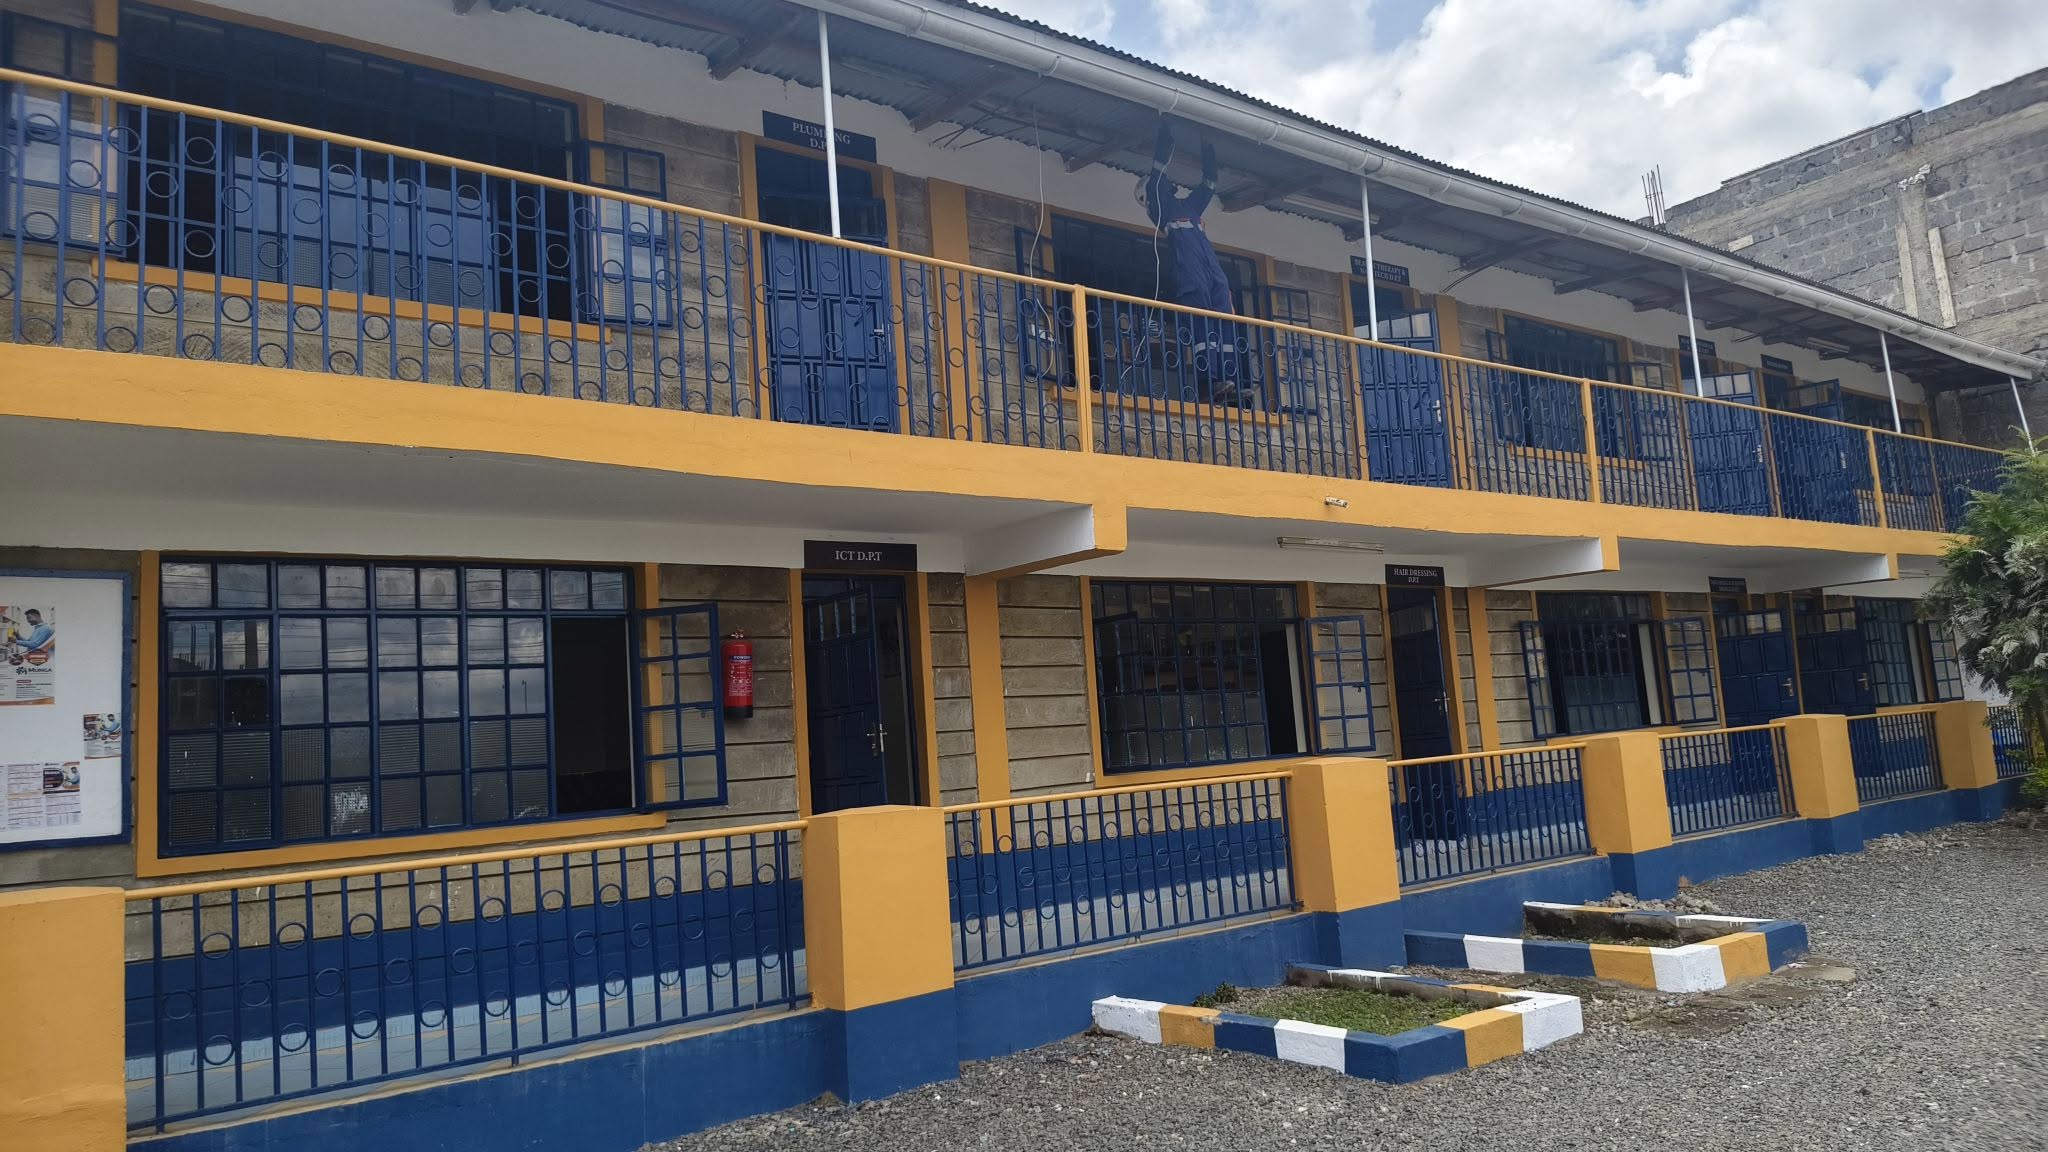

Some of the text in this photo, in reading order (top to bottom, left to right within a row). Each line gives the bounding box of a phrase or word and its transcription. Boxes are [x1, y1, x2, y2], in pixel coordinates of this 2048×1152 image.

[792, 121, 851, 145] PLUMNG
[835, 550, 883, 562] ICT D.P.T
[1394, 568, 1437, 577] HAIR DRESSING
